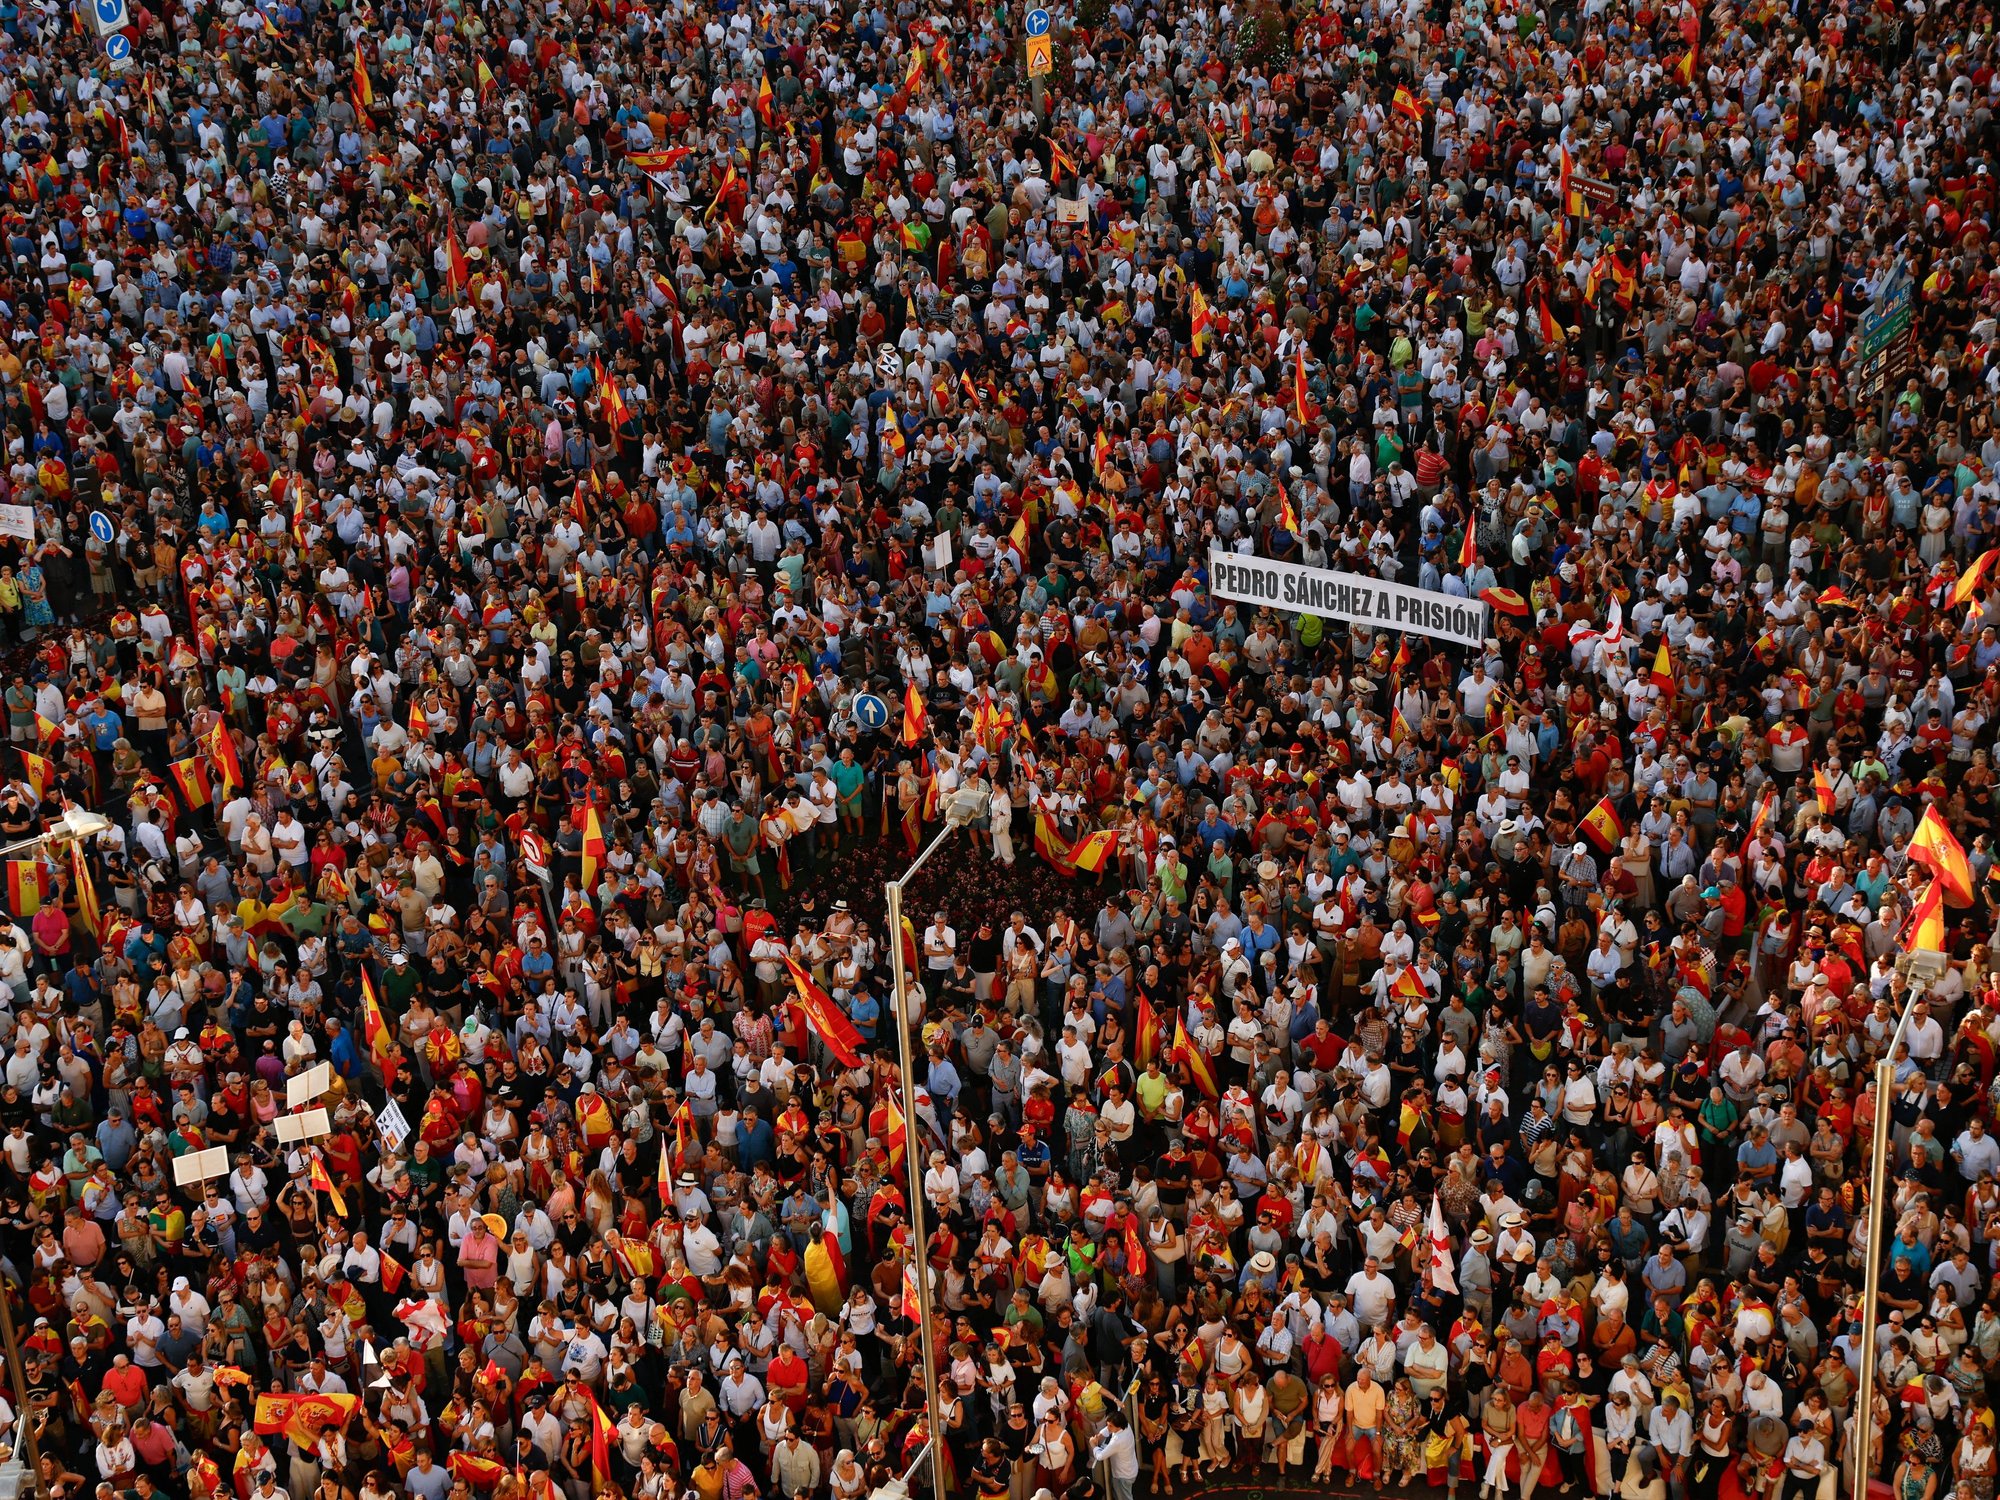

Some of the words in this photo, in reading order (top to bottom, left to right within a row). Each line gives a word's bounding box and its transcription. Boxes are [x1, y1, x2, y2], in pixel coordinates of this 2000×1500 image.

[1570, 181, 1583, 189] Casa
[1215, 562, 1280, 600] PEDRO
[1283, 572, 1372, 617] SÁNCHEZ
[1376, 592, 1391, 620] A
[1395, 596, 1481, 641] PRISIÓN
[1898, 668, 1914, 677] VANS
